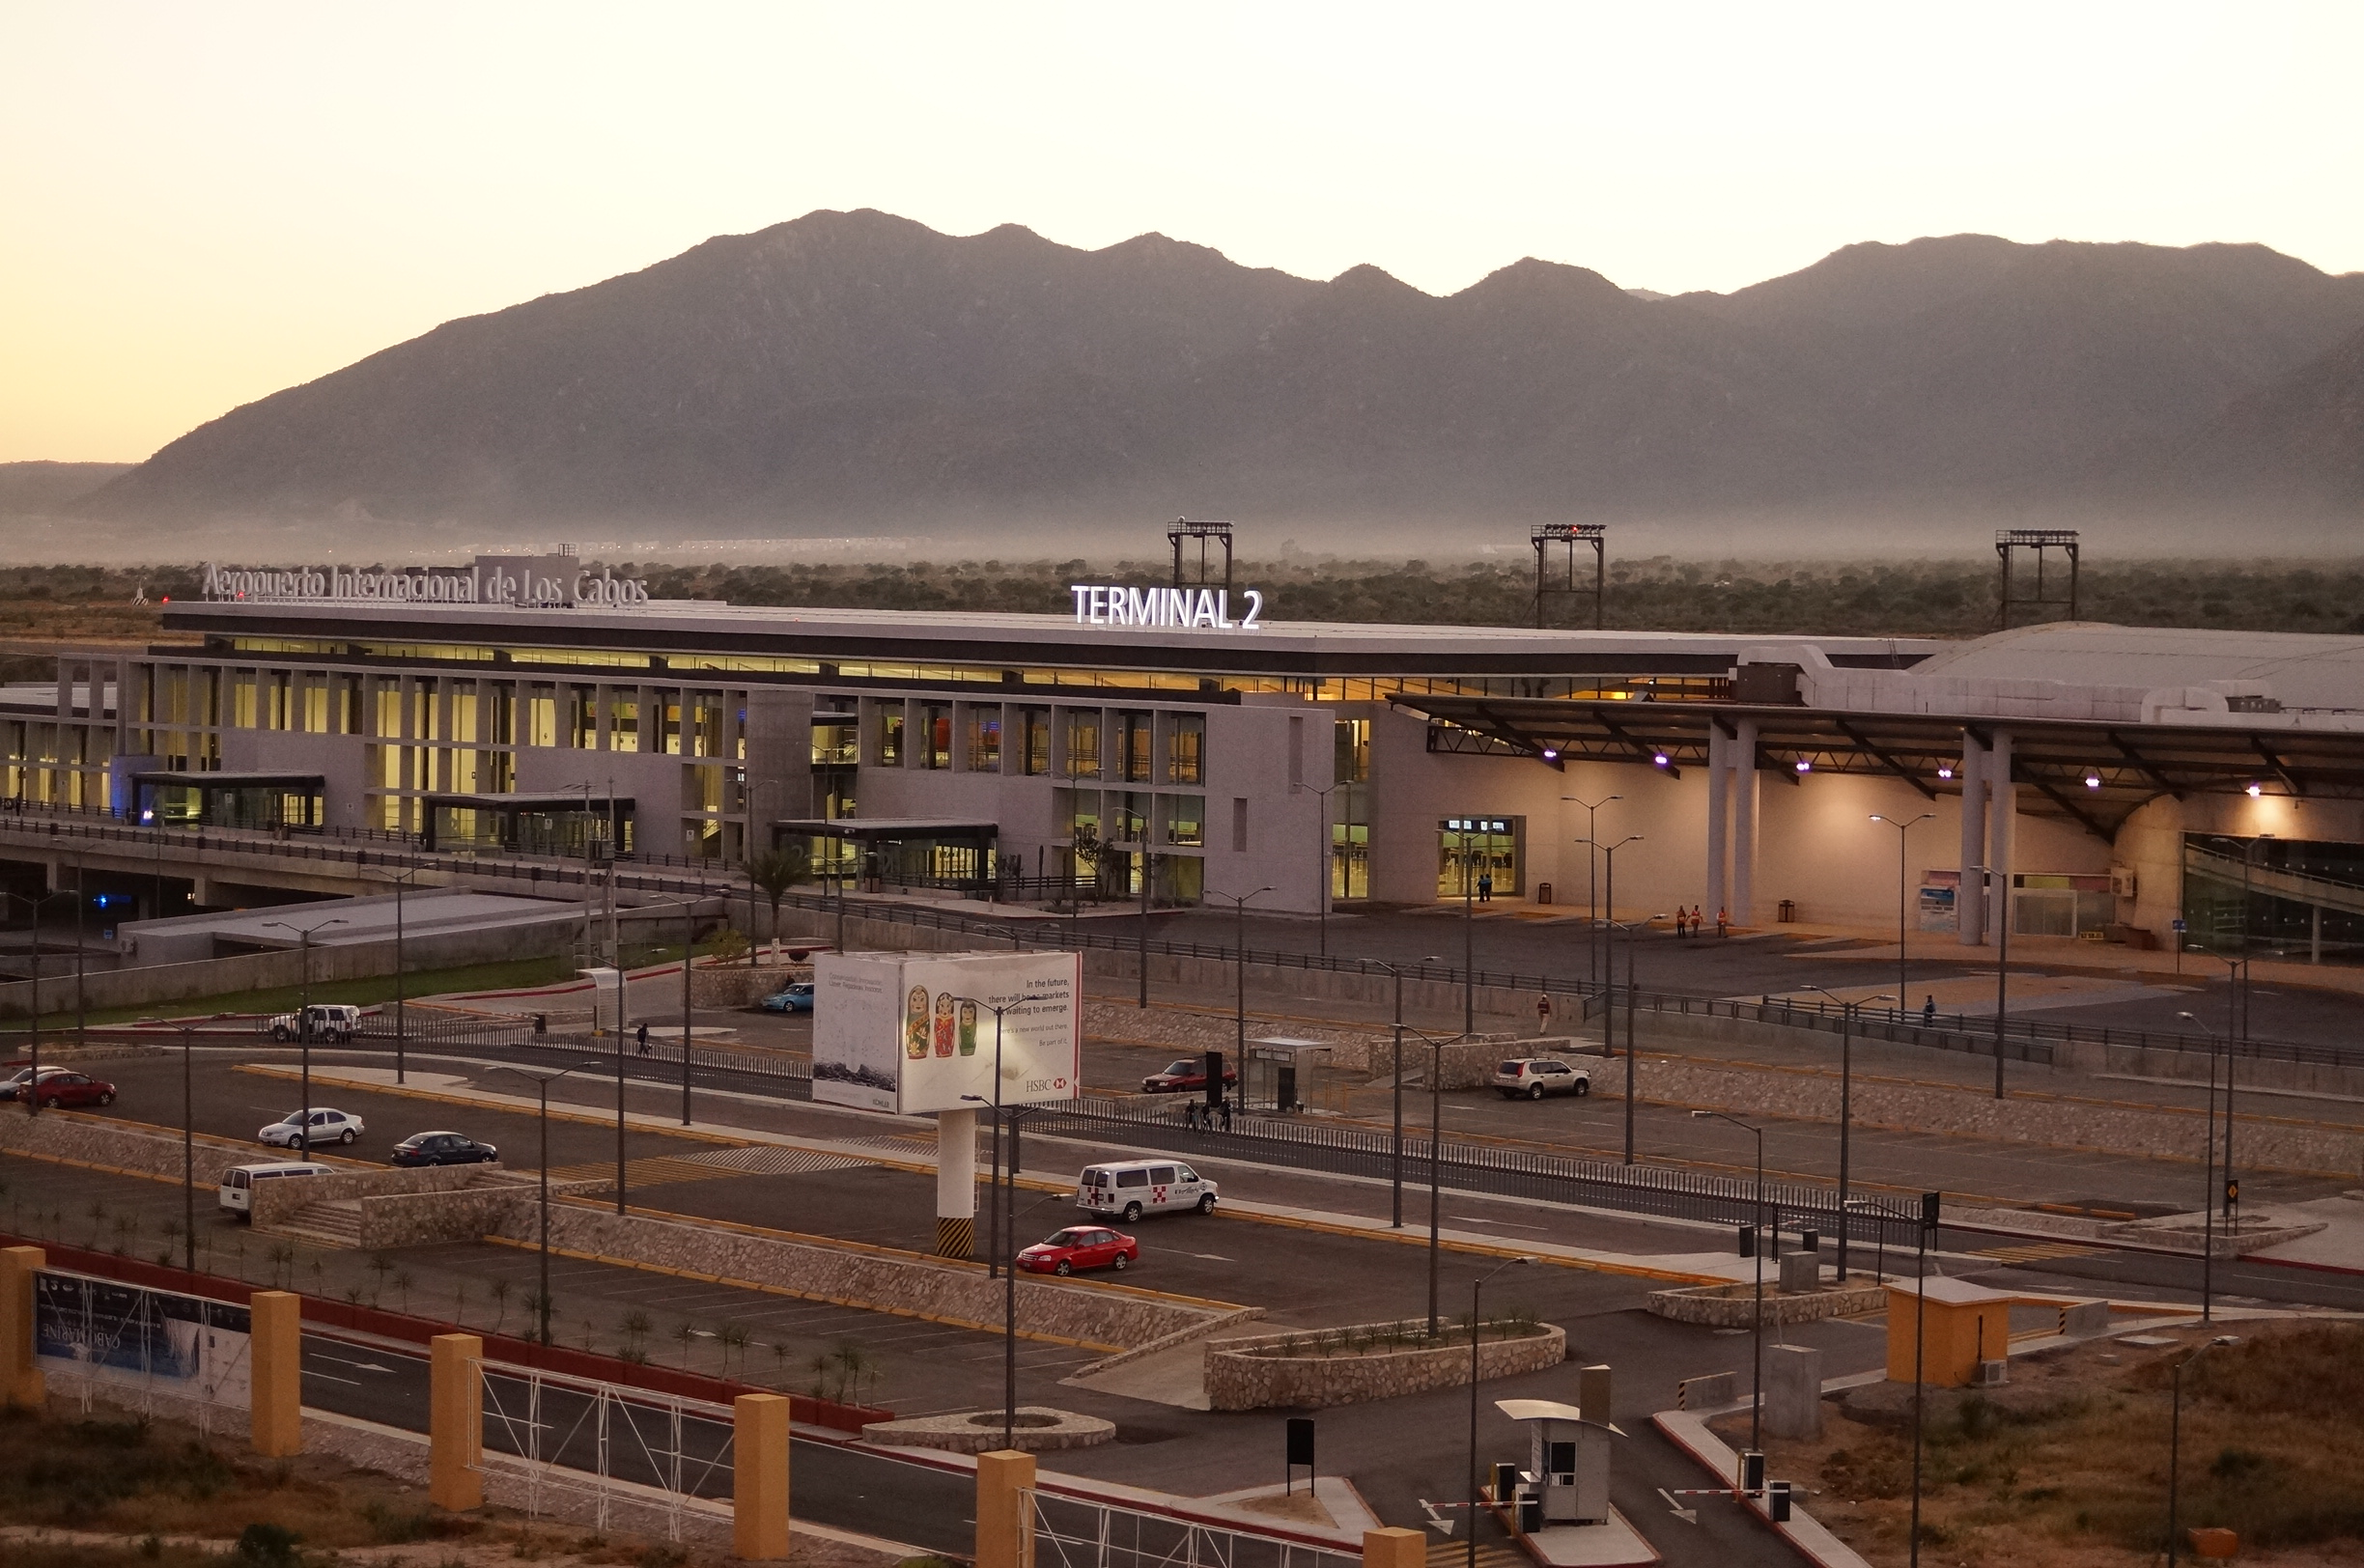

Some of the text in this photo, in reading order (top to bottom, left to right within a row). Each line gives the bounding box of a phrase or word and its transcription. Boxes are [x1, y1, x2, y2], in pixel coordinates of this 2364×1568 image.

[202, 564, 647, 605] Aeropuerto Internacional de Los Cabos
[1071, 585, 1263, 629] TERMINAL 2
[1027, 980, 1032, 989] In
[1034, 979, 1046, 988] the
[1007, 994, 1021, 1002] will
[1006, 1006, 1031, 1016] waiting
[1026, 1078, 1052, 1093] HSBC
